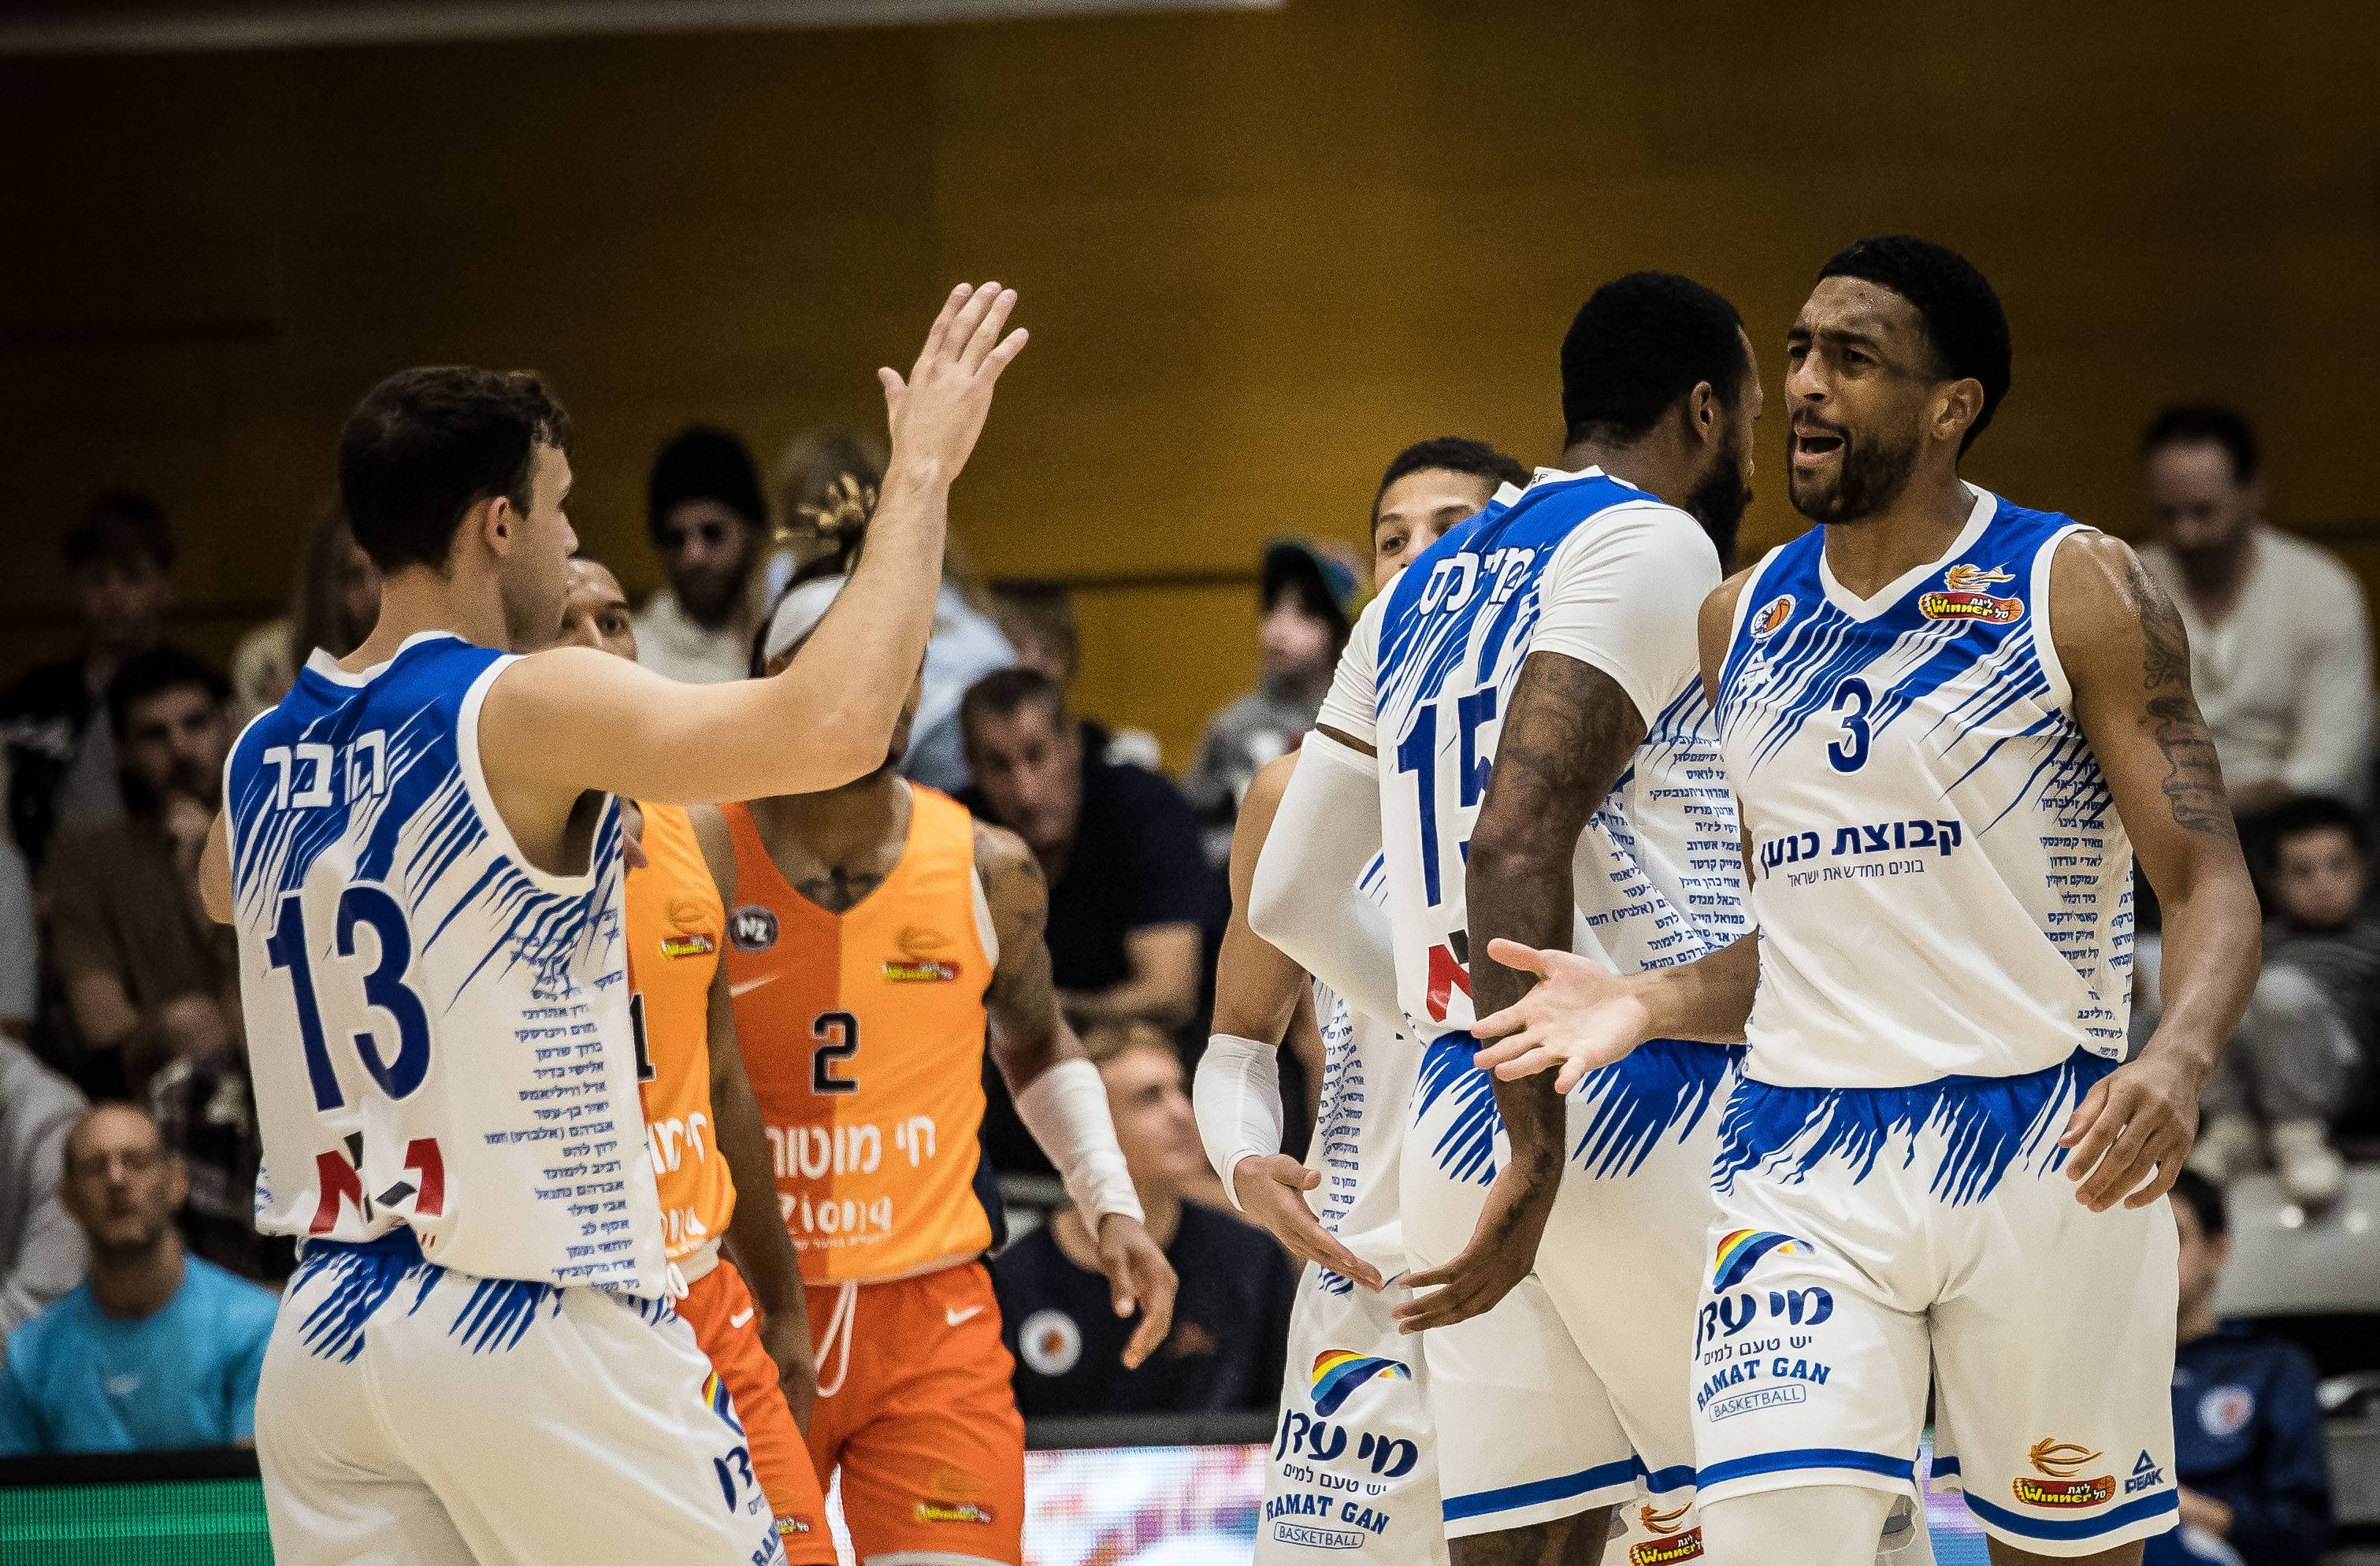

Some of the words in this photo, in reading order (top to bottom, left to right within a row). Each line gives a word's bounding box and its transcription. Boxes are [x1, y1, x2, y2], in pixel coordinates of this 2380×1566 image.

[1931, 599, 1993, 616] Winner
[1995, 607, 2011, 619] סל
[1827, 677, 1873, 774] 3
[1397, 686, 1497, 907] 15
[1831, 818, 1962, 857] קבוצת
[1760, 831, 1821, 880] כנען
[1888, 859, 1925, 875] בונים
[1823, 867, 1842, 882] את
[1844, 863, 1884, 880] מחדש
[265, 883, 430, 1113] 13
[811, 1010, 861, 1096] 2
[766, 1123, 882, 1180] מוטור
[1769, 1286, 1833, 1326] מי
[1703, 1342, 1732, 1366] למים
[1740, 1338, 1781, 1356] טעם
[1789, 1334, 1813, 1349] יש
[1772, 1357, 1833, 1386] GAN
[1713, 1386, 1802, 1418] BASKETBALL
[1357, 1432, 1418, 1478] מי
[1283, 1462, 1314, 1483] למים
[1320, 1473, 1359, 1493] טעם
[2124, 1466, 2165, 1495] PEAK
[1366, 1483, 1387, 1496] יש
[2022, 1485, 2091, 1504] Winner
[1265, 1494, 1334, 1523] RAMAT
[1340, 1501, 1391, 1535] GAN
[1278, 1524, 1360, 1547] BASKETBALL
[1640, 1543, 1695, 1564] Winner
